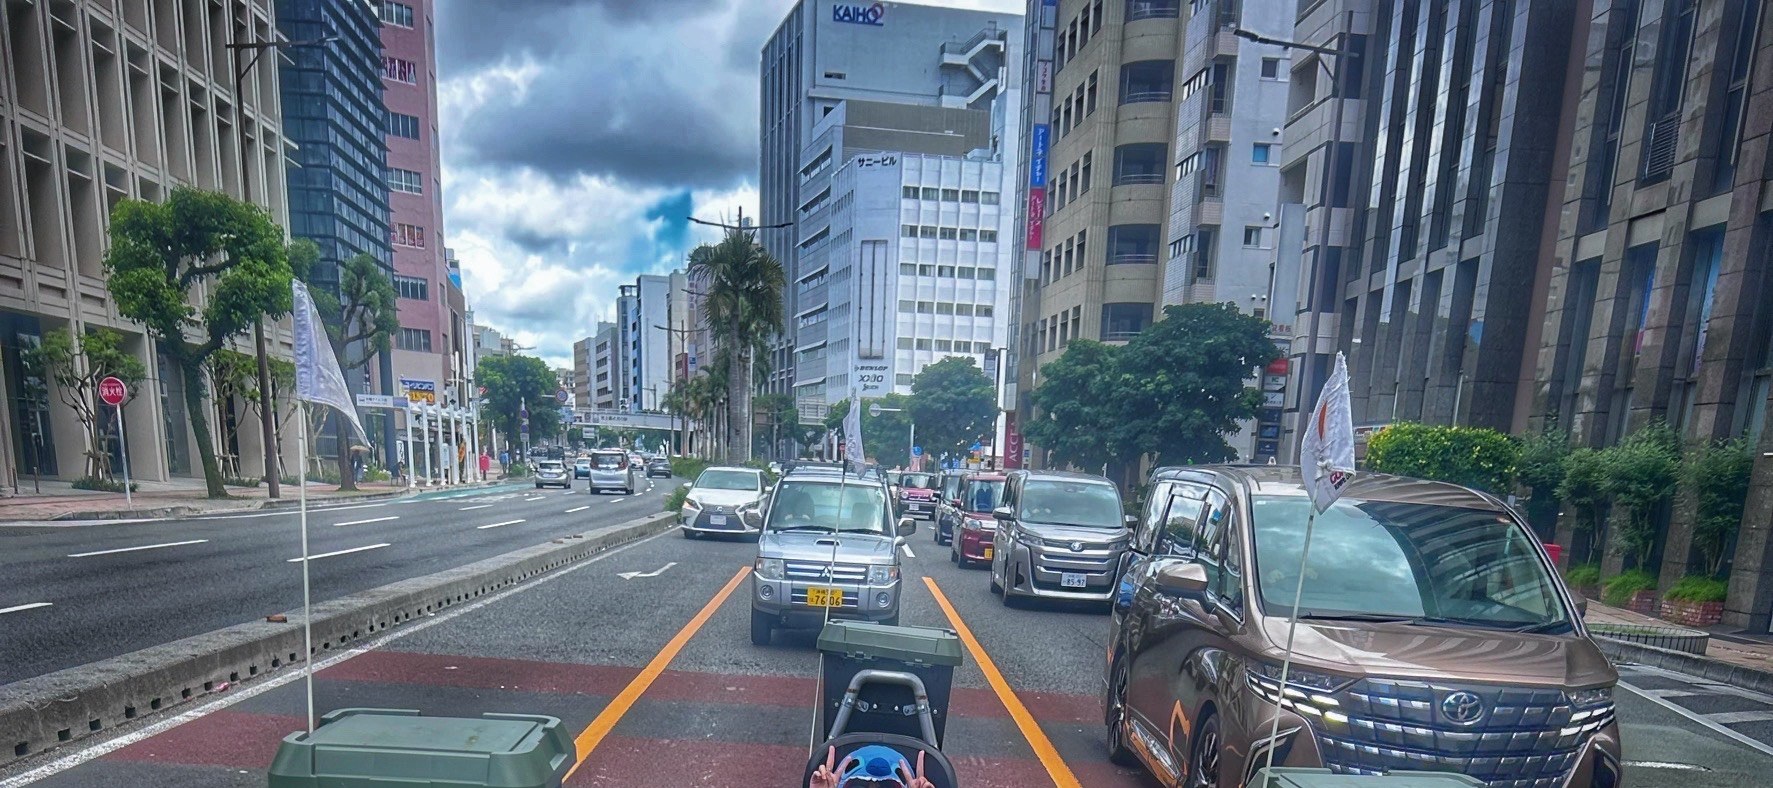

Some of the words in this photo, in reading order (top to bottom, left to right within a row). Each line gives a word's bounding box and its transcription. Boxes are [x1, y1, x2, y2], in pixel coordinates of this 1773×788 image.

[833, 3, 884, 25] KAIHO
[858, 156, 897, 168] サニービル
[101, 386, 123, 397] 消火栓
